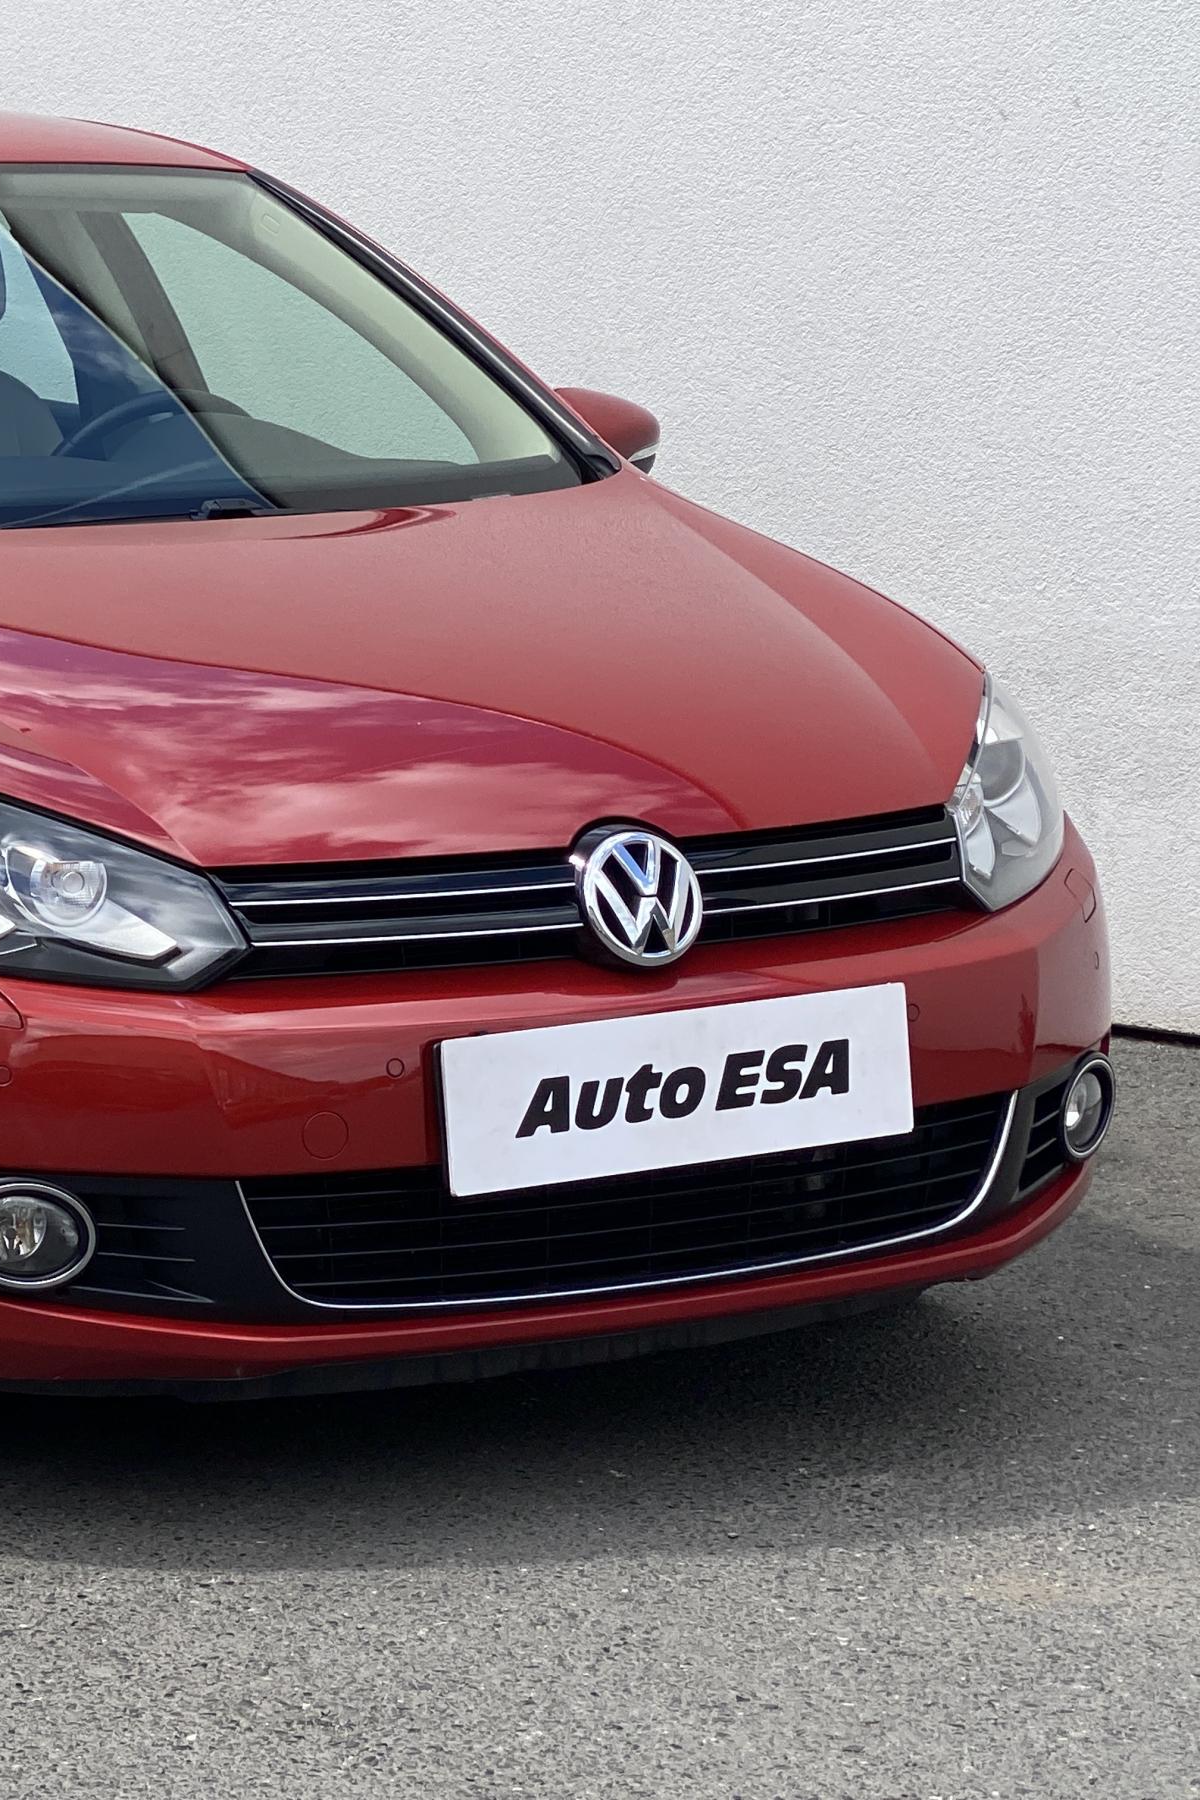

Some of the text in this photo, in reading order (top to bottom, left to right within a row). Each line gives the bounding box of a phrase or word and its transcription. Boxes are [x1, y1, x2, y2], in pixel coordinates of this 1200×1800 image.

[586, 834, 701, 962] VW
[515, 1038, 849, 1138] Auto ESA
